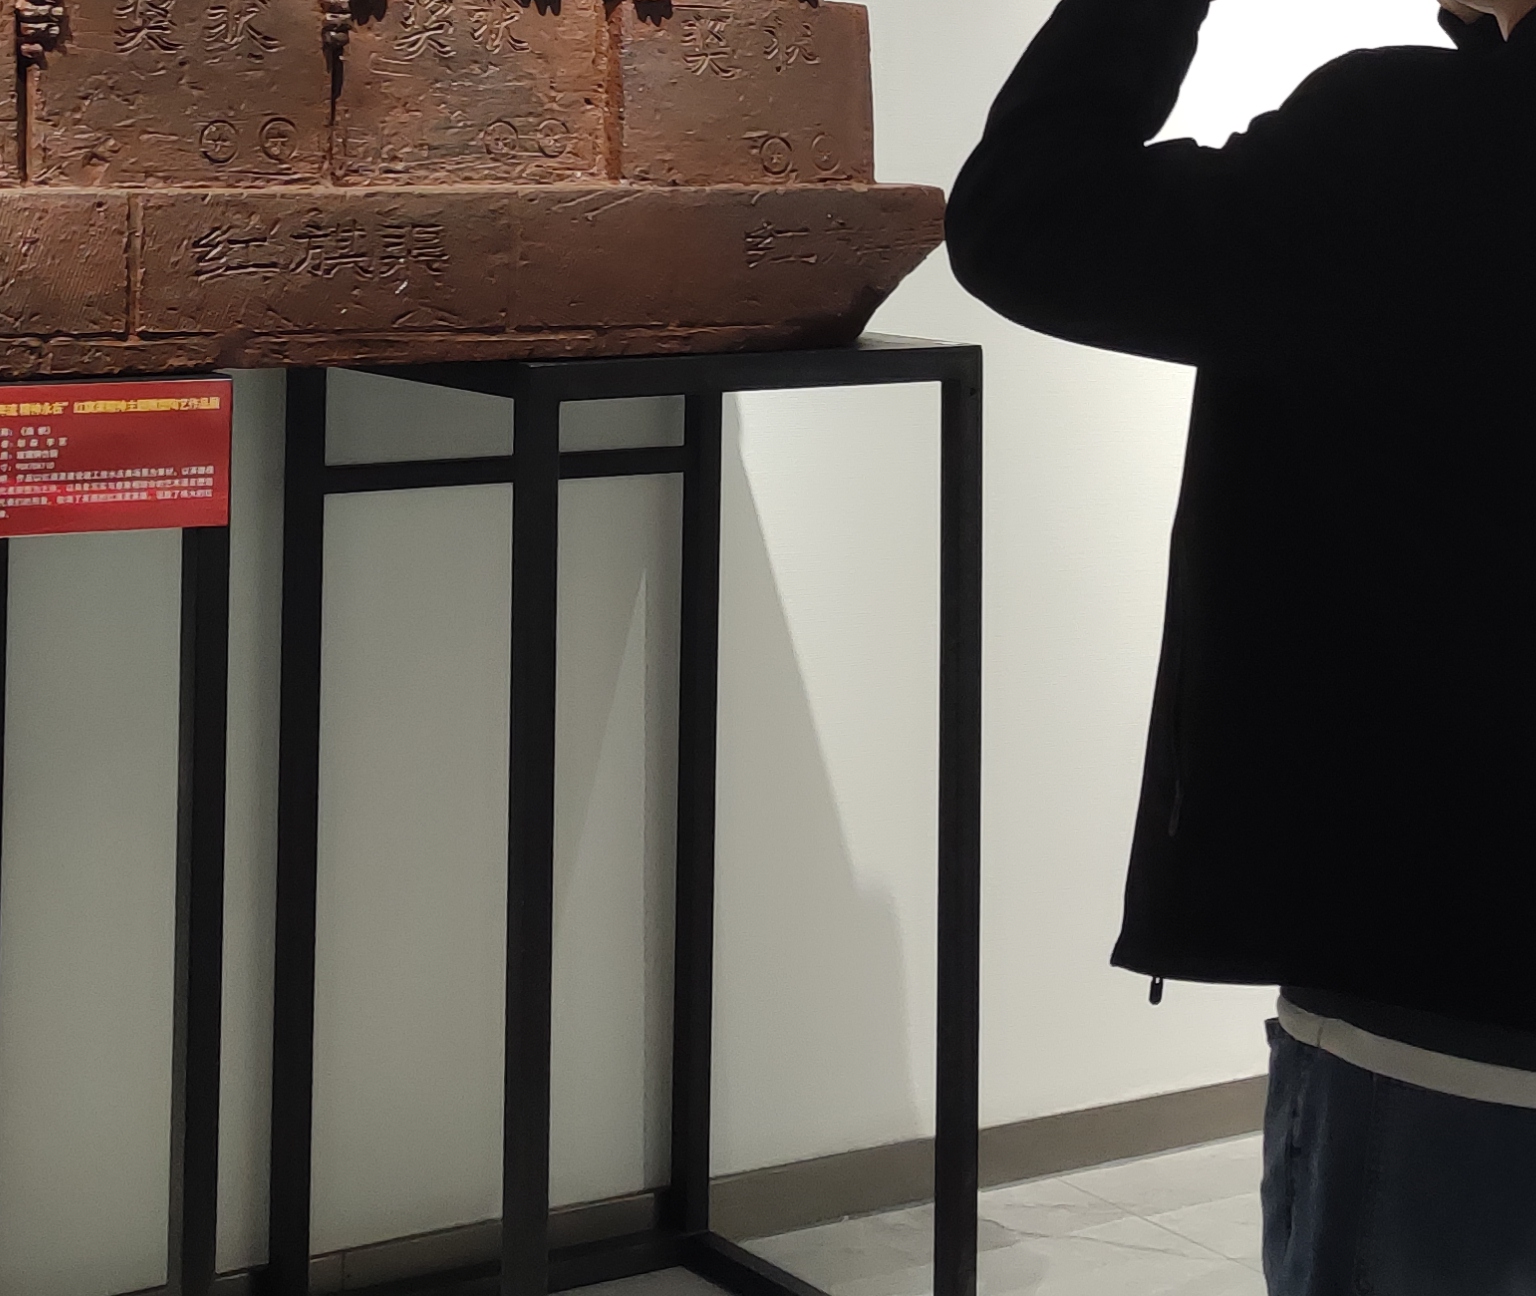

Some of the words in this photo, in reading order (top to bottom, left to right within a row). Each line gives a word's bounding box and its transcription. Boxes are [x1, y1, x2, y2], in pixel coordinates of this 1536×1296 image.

[681, 14, 822, 80] 奖状
[192, 218, 450, 281] 红旗渠
